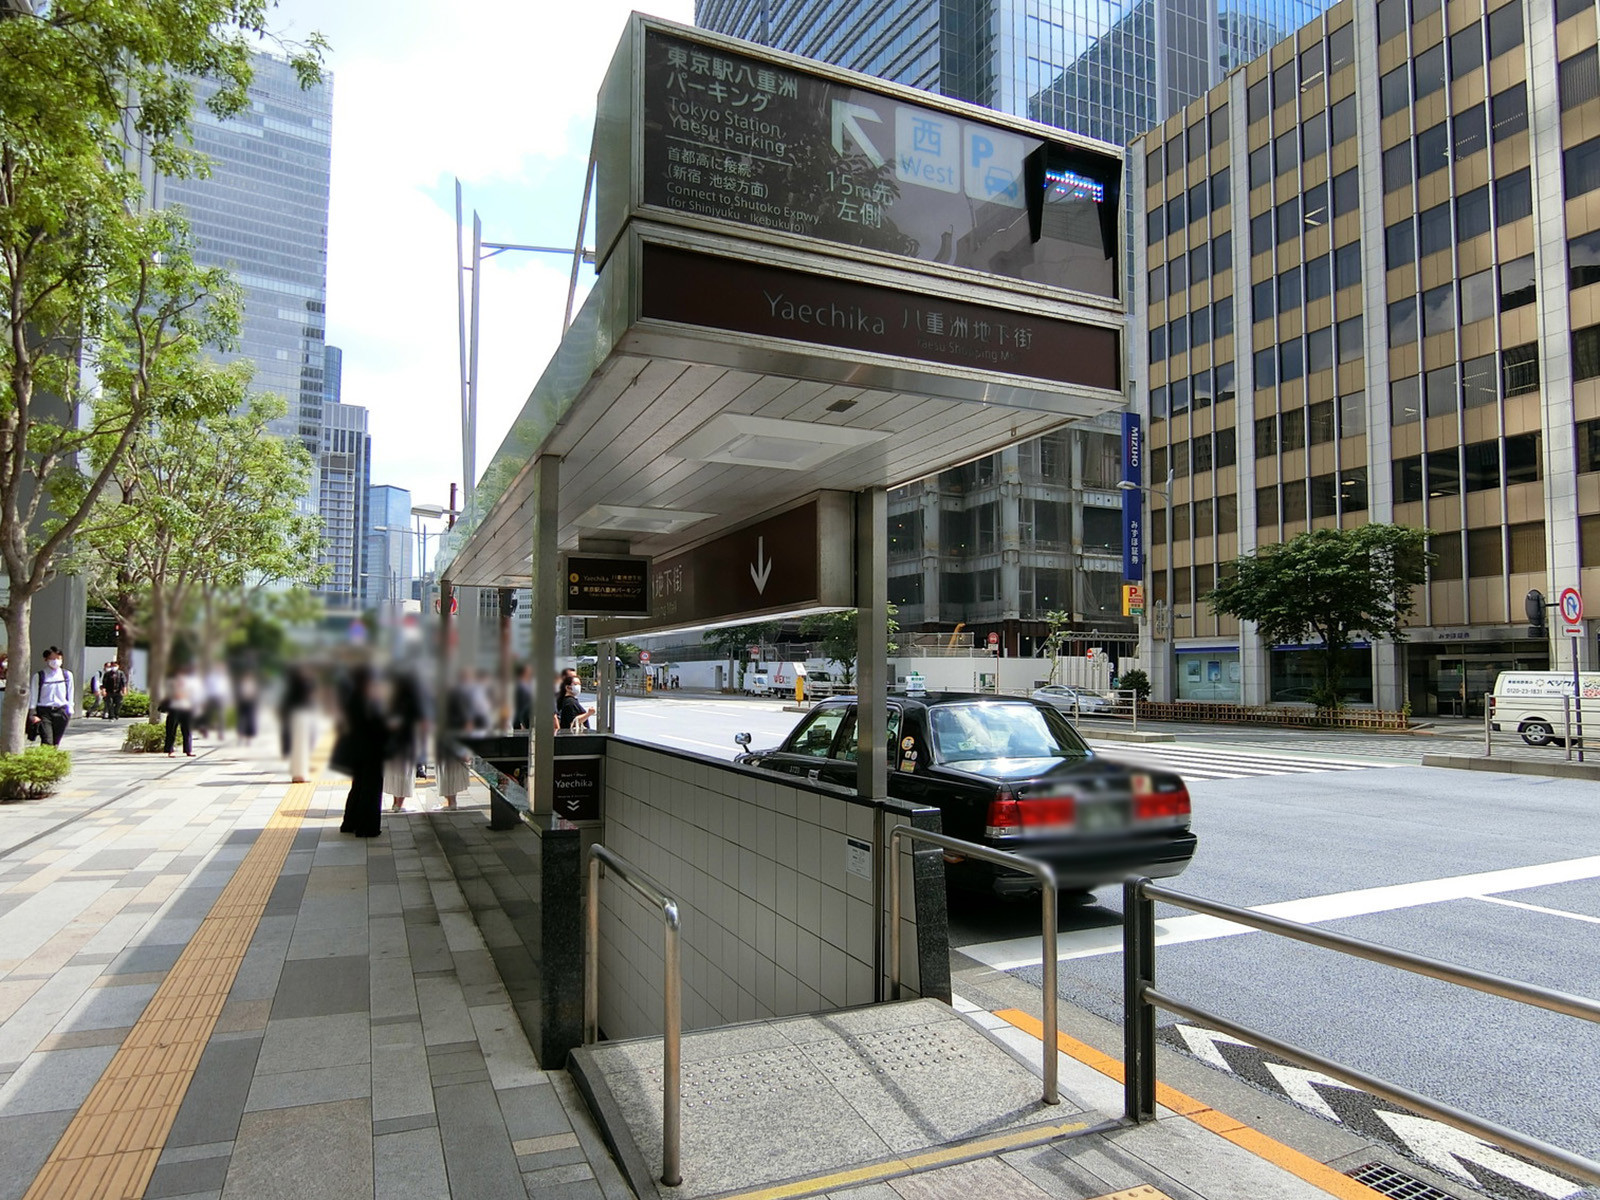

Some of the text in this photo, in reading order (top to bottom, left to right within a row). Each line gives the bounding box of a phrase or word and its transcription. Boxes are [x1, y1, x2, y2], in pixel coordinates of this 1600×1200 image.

[666, 46, 798, 100] 東京駅八重洲
[666, 71, 772, 113] パーキング
[668, 95, 720, 122] Tokyo
[668, 112, 786, 157] Yaesu Parking
[912, 116, 943, 157] 西
[971, 134, 994, 169] P
[667, 146, 752, 178] 首都高に接続
[900, 153, 955, 186] West
[666, 181, 823, 226] Connect to Shutoko Expwy.
[666, 195, 805, 234] (for Shinjyuku Ikebukuro)
[836, 197, 881, 229] 左側
[763, 289, 885, 335] Yaechika
[902, 308, 1033, 350] 八重洲地下街
[1131, 426, 1139, 468] MIZUHO
[651, 563, 683, 600] 地下街
[554, 779, 593, 789] Yaechika
